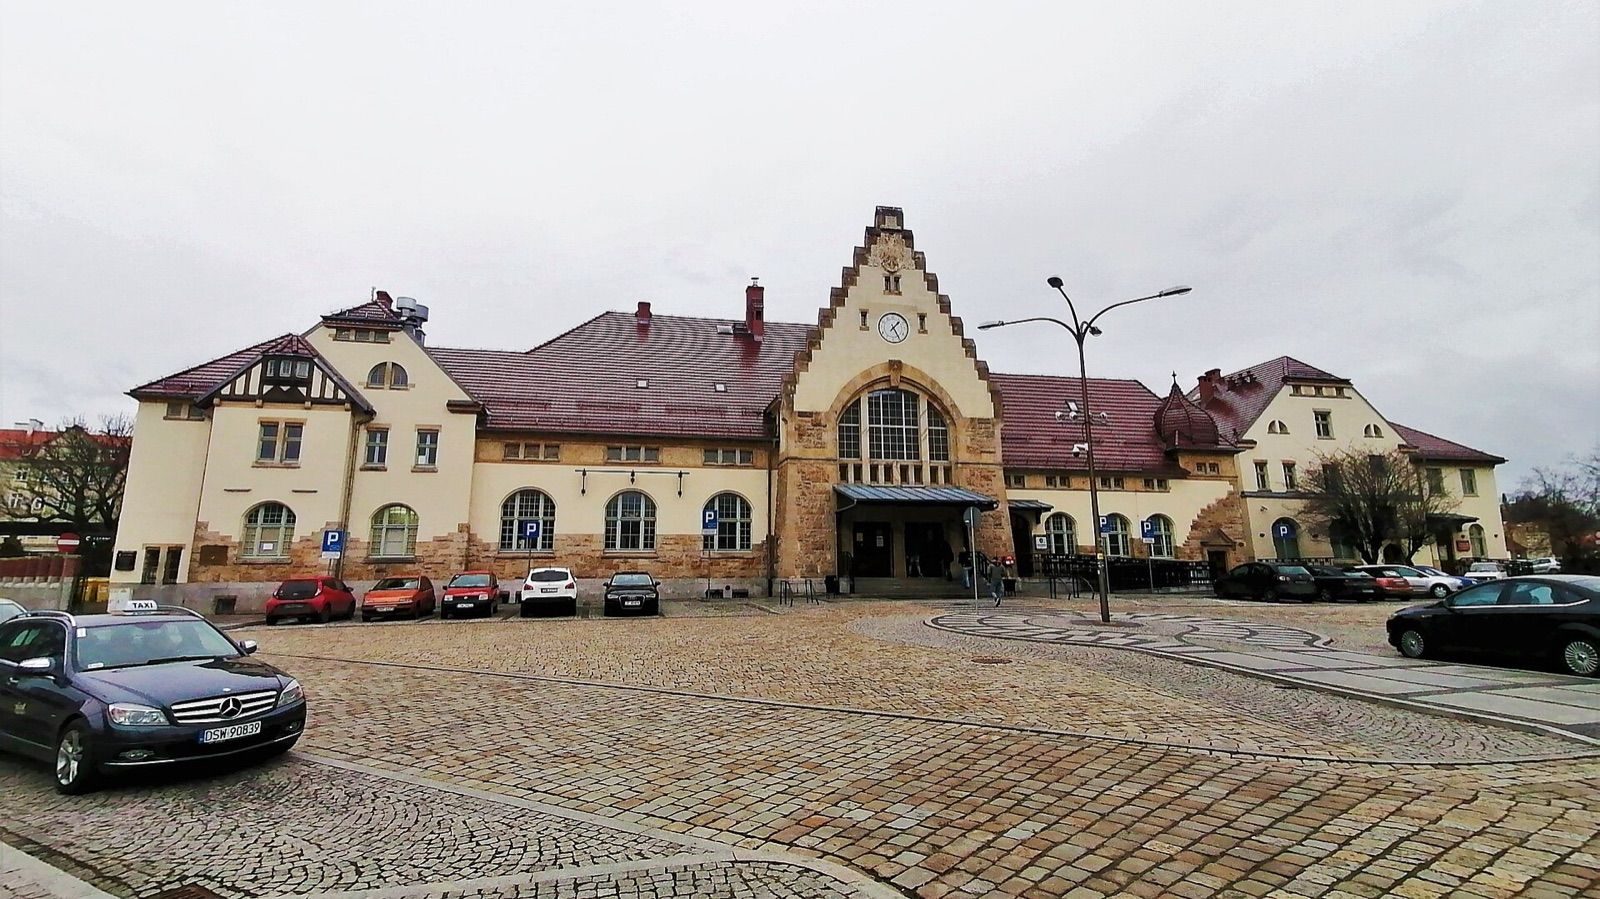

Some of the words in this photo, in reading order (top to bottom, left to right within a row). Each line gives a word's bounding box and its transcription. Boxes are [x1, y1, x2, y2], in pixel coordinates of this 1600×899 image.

[705, 511, 714, 523] P
[1099, 517, 1107, 528] P
[527, 523, 536, 536] P
[1143, 522, 1151, 533] P
[1280, 526, 1287, 537] P
[327, 532, 338, 545] P
[205, 727, 227, 741] DSW
[229, 722, 260, 738] 90839
